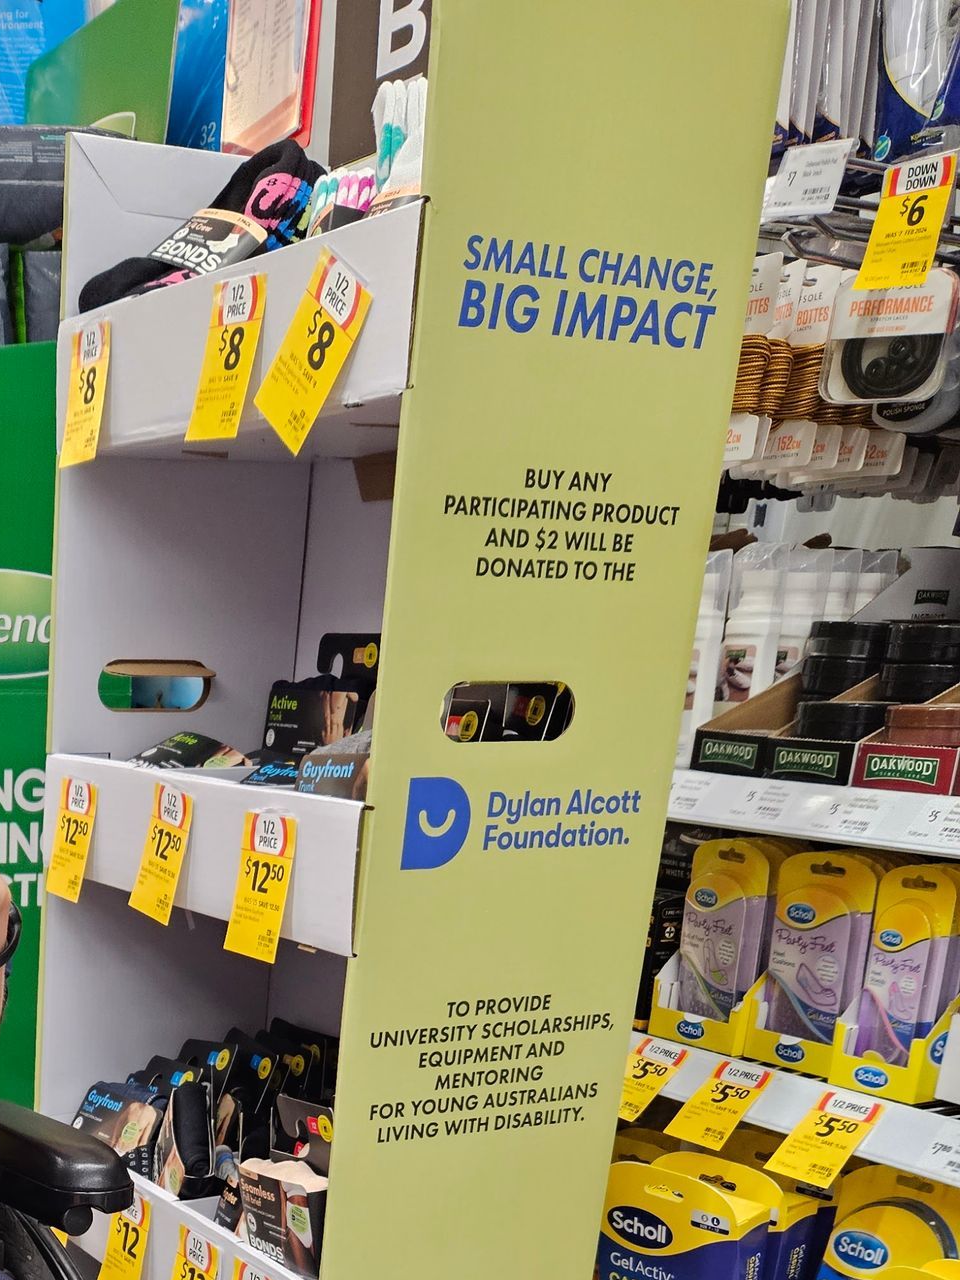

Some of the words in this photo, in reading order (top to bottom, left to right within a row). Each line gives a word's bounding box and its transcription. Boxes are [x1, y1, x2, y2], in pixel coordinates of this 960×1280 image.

[16, 9, 29, 18] for
[908, 161, 938, 179] DOWN
[906, 175, 937, 191] DOWN
[900, 195, 928, 226] $6
[156, 240, 221, 272] BONDS
[464, 234, 568, 280] SMALL
[579, 249, 717, 301] CHANGE,
[232, 287, 244, 301] 1/2
[335, 272, 349, 296] 1/2
[227, 302, 246, 317] PRICE
[325, 288, 347, 316] PRICE
[849, 295, 934, 317] PERFORMANCE
[458, 280, 540, 333] BIG
[552, 290, 716, 349] IMPACT
[796, 306, 829, 326] BOTTES
[219, 325, 244, 370] $8
[308, 306, 335, 370] $8
[79, 366, 96, 404] $8
[525, 468, 565, 489] BUY
[568, 471, 613, 492] ANY
[444, 495, 587, 521] PARTICIPATING
[592, 503, 680, 525] PRODUCT
[485, 528, 529, 548] AND
[535, 527, 558, 551] $2
[565, 531, 607, 551] WILL
[612, 533, 634, 552] BE
[476, 557, 568, 579] DONATED
[574, 561, 597, 580] TO
[603, 562, 636, 581] THE
[271, 696, 298, 711] Active
[705, 742, 753, 760] OAKWOOD
[779, 750, 833, 768] OAKWOOD
[302, 759, 355, 781] Guyfront
[871, 758, 933, 776] OAKWOOD
[167, 793, 176, 807] 1/2
[487, 791, 560, 824] Dylan
[566, 789, 641, 815] Alcott
[164, 807, 178, 821] PRICE
[264, 820, 275, 835] 1/2
[483, 821, 629, 850] Foundation.
[259, 836, 277, 849] PRICE
[696, 892, 716, 904] Scholl
[789, 906, 814, 920] Scholl
[881, 933, 902, 945] Scholl
[447, 1001, 470, 1018] TO
[475, 994, 552, 1015] PROVIDE
[370, 1024, 477, 1048] UNIVERSITY
[481, 1013, 615, 1038] SCHOLARSHIPS,
[679, 1023, 702, 1036] Scholl
[418, 1044, 523, 1068] EQUIPMENT
[526, 1040, 565, 1058] AND
[777, 1046, 802, 1060] Scholl
[435, 1066, 543, 1091] MENTORING
[728, 1068, 739, 1076] 1/2
[740, 1071, 761, 1082] PRICE
[855, 1069, 886, 1085] Scholl
[88, 1089, 123, 1112] Guyfront
[369, 1103, 405, 1120] FOR
[411, 1095, 478, 1116] YOUNG
[483, 1082, 598, 1109] AUSTRALIANS
[832, 1099, 844, 1109] 1/2
[845, 1102, 871, 1115] PRICE
[377, 1122, 438, 1143] LIVING
[444, 1117, 489, 1136] WITH
[495, 1107, 585, 1130] DISABILITY.
[241, 1178, 275, 1201] Seamless
[117, 1215, 139, 1259] $12
[612, 1210, 667, 1244] Scholl
[250, 1234, 284, 1259] BONDS
[839, 1236, 885, 1265] Scholl
